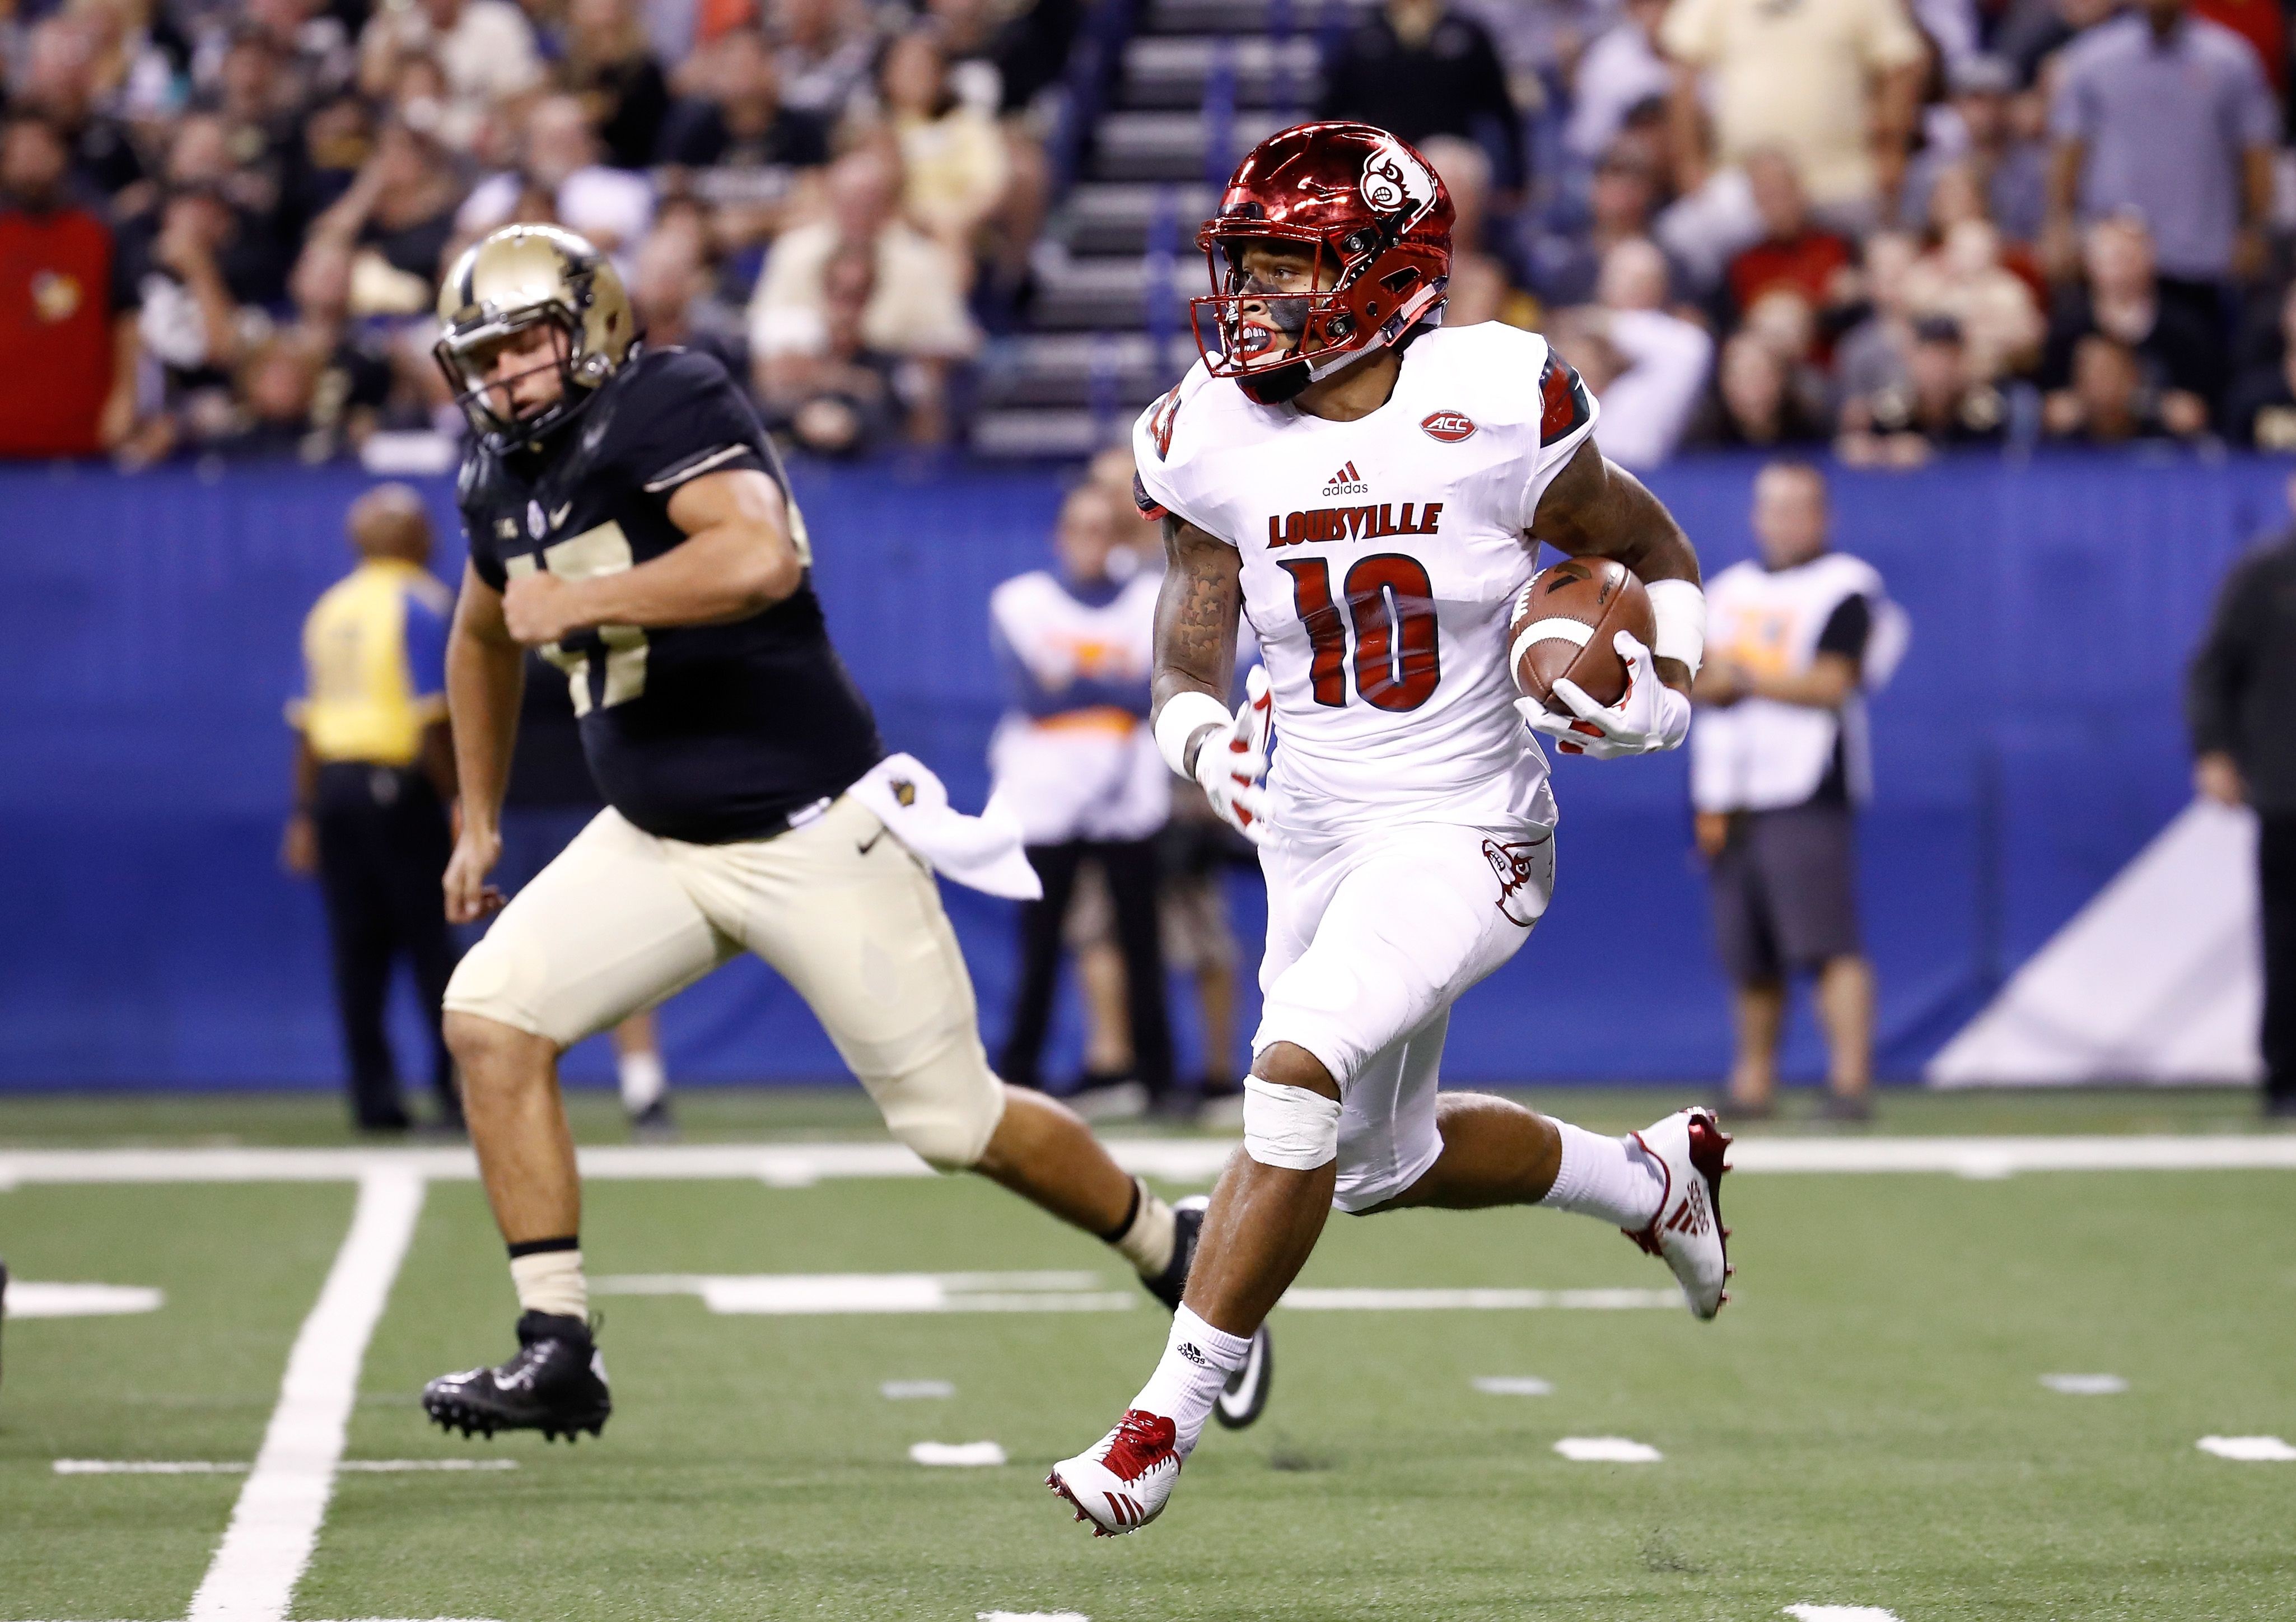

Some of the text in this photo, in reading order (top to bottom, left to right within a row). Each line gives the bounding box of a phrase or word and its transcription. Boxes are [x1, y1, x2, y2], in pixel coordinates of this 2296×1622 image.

[1427, 417, 1469, 430] ACC
[1323, 482, 1368, 496] adidas
[1266, 503, 1443, 549] LOUISVILLE
[1276, 553, 1441, 712] 10
[1177, 1344, 1206, 1364] adidas
